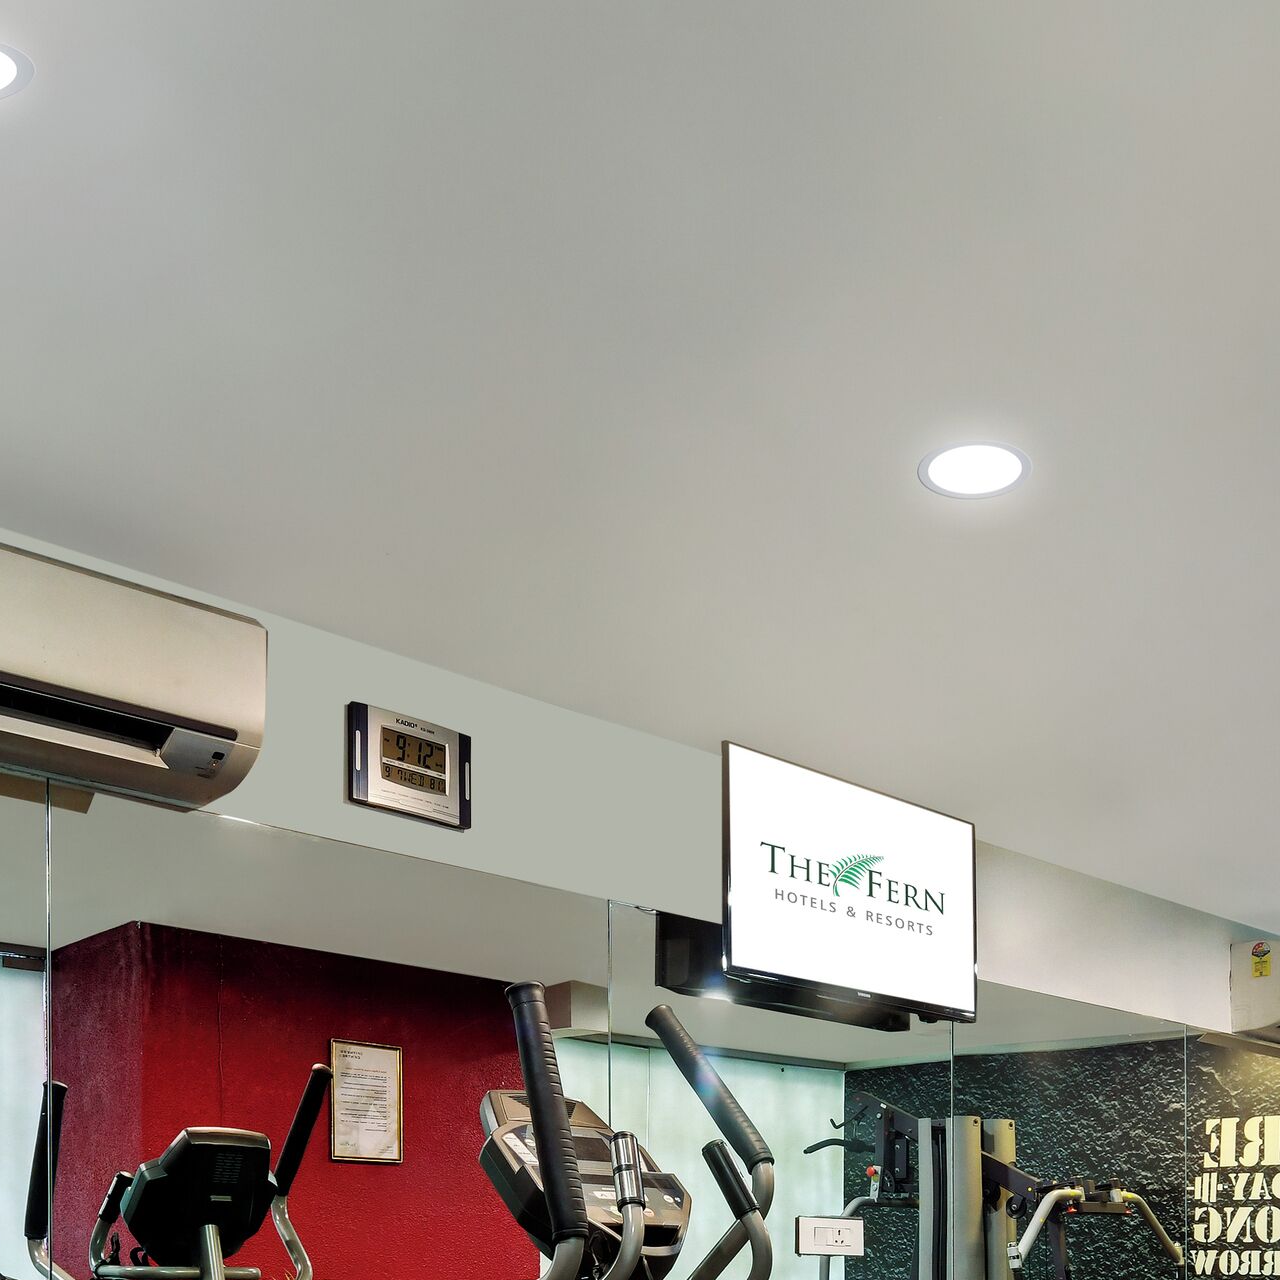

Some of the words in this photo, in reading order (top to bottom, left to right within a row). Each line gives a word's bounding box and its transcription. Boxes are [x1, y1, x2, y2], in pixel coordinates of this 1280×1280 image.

[395, 718, 415, 729] KADIO
[760, 841, 830, 887] THE
[866, 868, 945, 915] FERN
[774, 888, 836, 913] HOTELS
[846, 906, 856, 918] &
[866, 910, 933, 936] RESORTS
